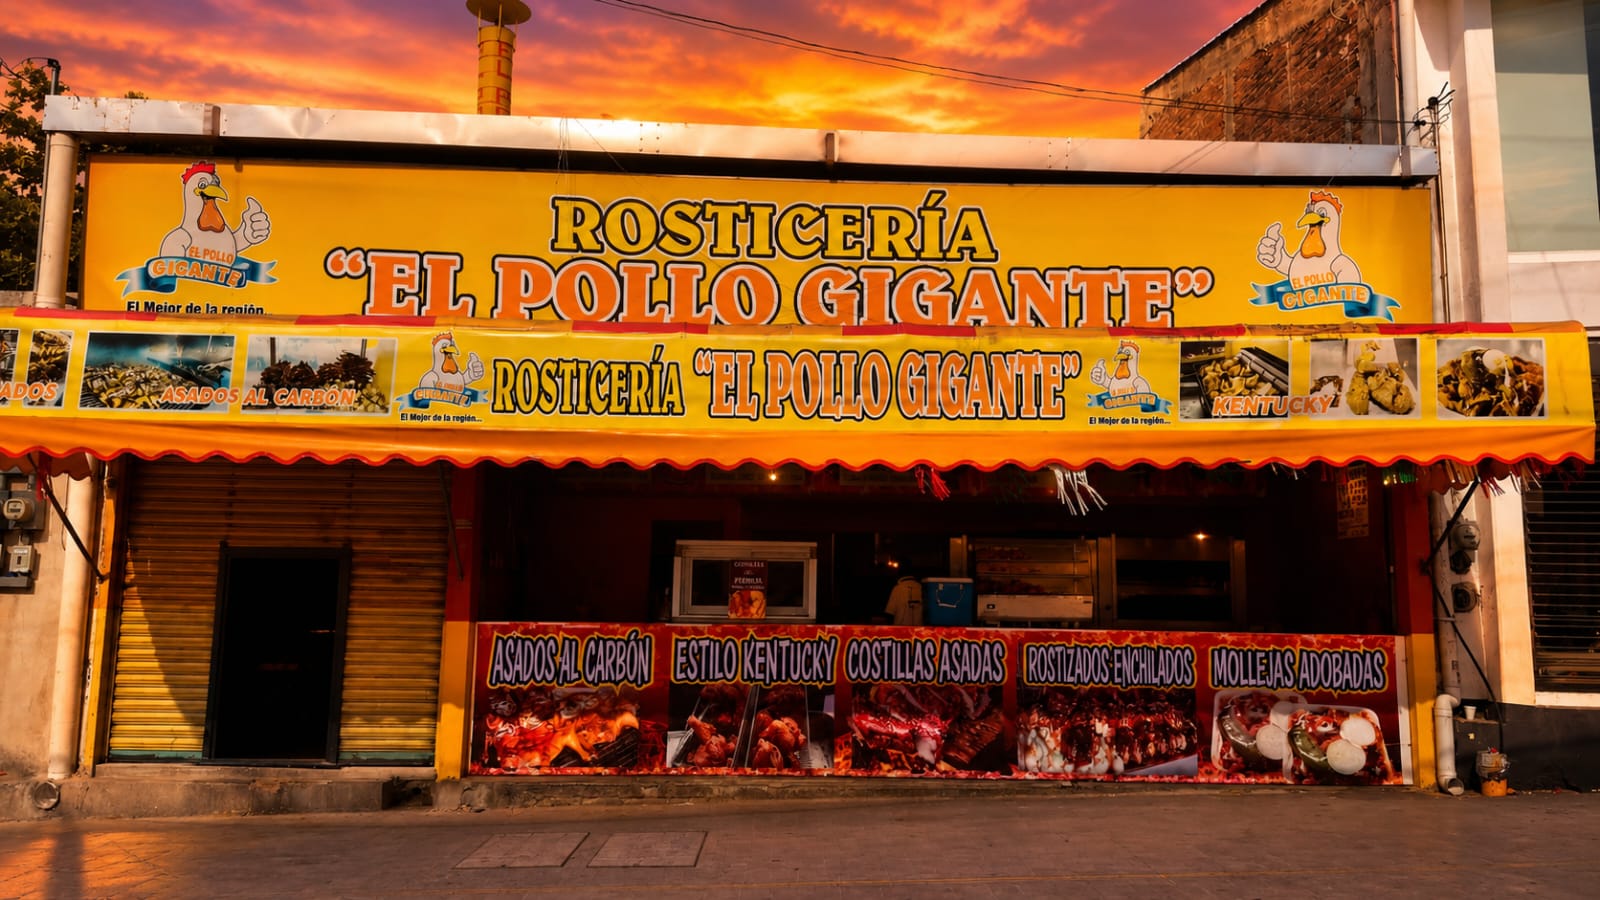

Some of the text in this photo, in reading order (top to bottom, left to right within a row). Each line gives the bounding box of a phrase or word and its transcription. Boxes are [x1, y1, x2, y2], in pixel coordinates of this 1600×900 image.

[551, 189, 999, 262] ROSTICERÍA
[152, 260, 241, 287] GIGANTE
[189, 245, 234, 266] EL POLLO
[325, 247, 1214, 327] “EL POLLO GIGANTE”
[1282, 285, 1368, 309] GIGANTE
[1292, 272, 1334, 288] EL POLLO
[127, 301, 139, 312] El
[186, 303, 201, 314] de
[206, 304, 217, 314] la
[160, 384, 356, 406] ASADOS AL CARBÓN
[491, 344, 1082, 420] ROSTICERÍA “EL POLLO GIGANTE”
[1212, 396, 1333, 416] KENTUCKY
[491, 631, 650, 684] ASADOS AL CARBÓN
[675, 636, 836, 684] ESTILO KENTUCKY
[848, 639, 1003, 684] COSTILLAS ASADAS
[1027, 645, 1194, 687] ROSTIZADOS ENCHILADOS
[1213, 649, 1386, 690] MOLLEJAS ADOBADAS
